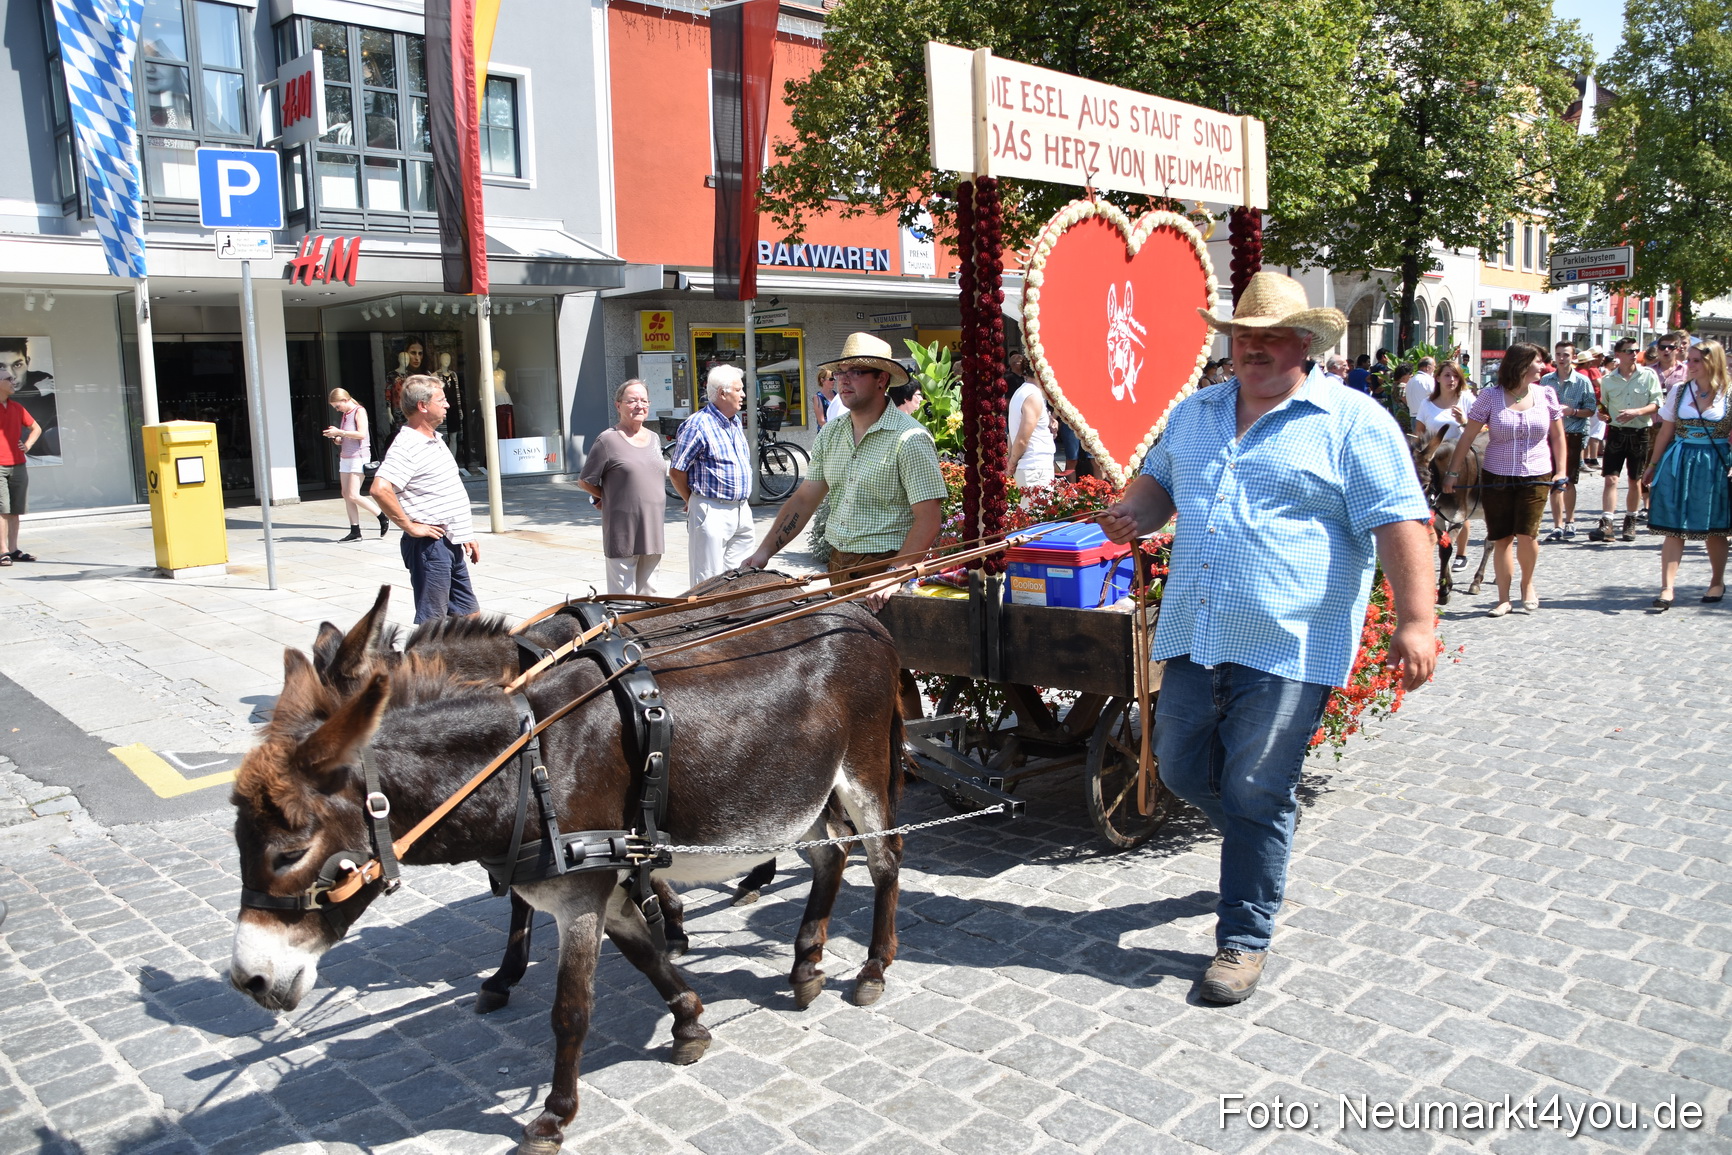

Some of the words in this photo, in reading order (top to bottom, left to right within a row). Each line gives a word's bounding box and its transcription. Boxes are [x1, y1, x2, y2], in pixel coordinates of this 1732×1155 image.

[282, 70, 312, 128] H&M
[991, 75, 1014, 110] IE
[1020, 80, 1069, 120] ESEL
[1078, 94, 1120, 130] AUS
[1130, 105, 1182, 141] STAUF
[1193, 118, 1232, 154] SIND
[1045, 133, 1100, 179] HERZ
[1108, 145, 1145, 186] VON
[1155, 153, 1241, 194] NEUMARKT
[217, 159, 260, 218] P
[287, 234, 361, 287] H&M
[1563, 253, 1616, 266] Parkleitsystem
[1581, 268, 1616, 277] Rosengasse
[644, 332, 671, 342] LOTTO
[513, 447, 541, 455] SEASON
[1012, 578, 1044, 591] Coolbox
